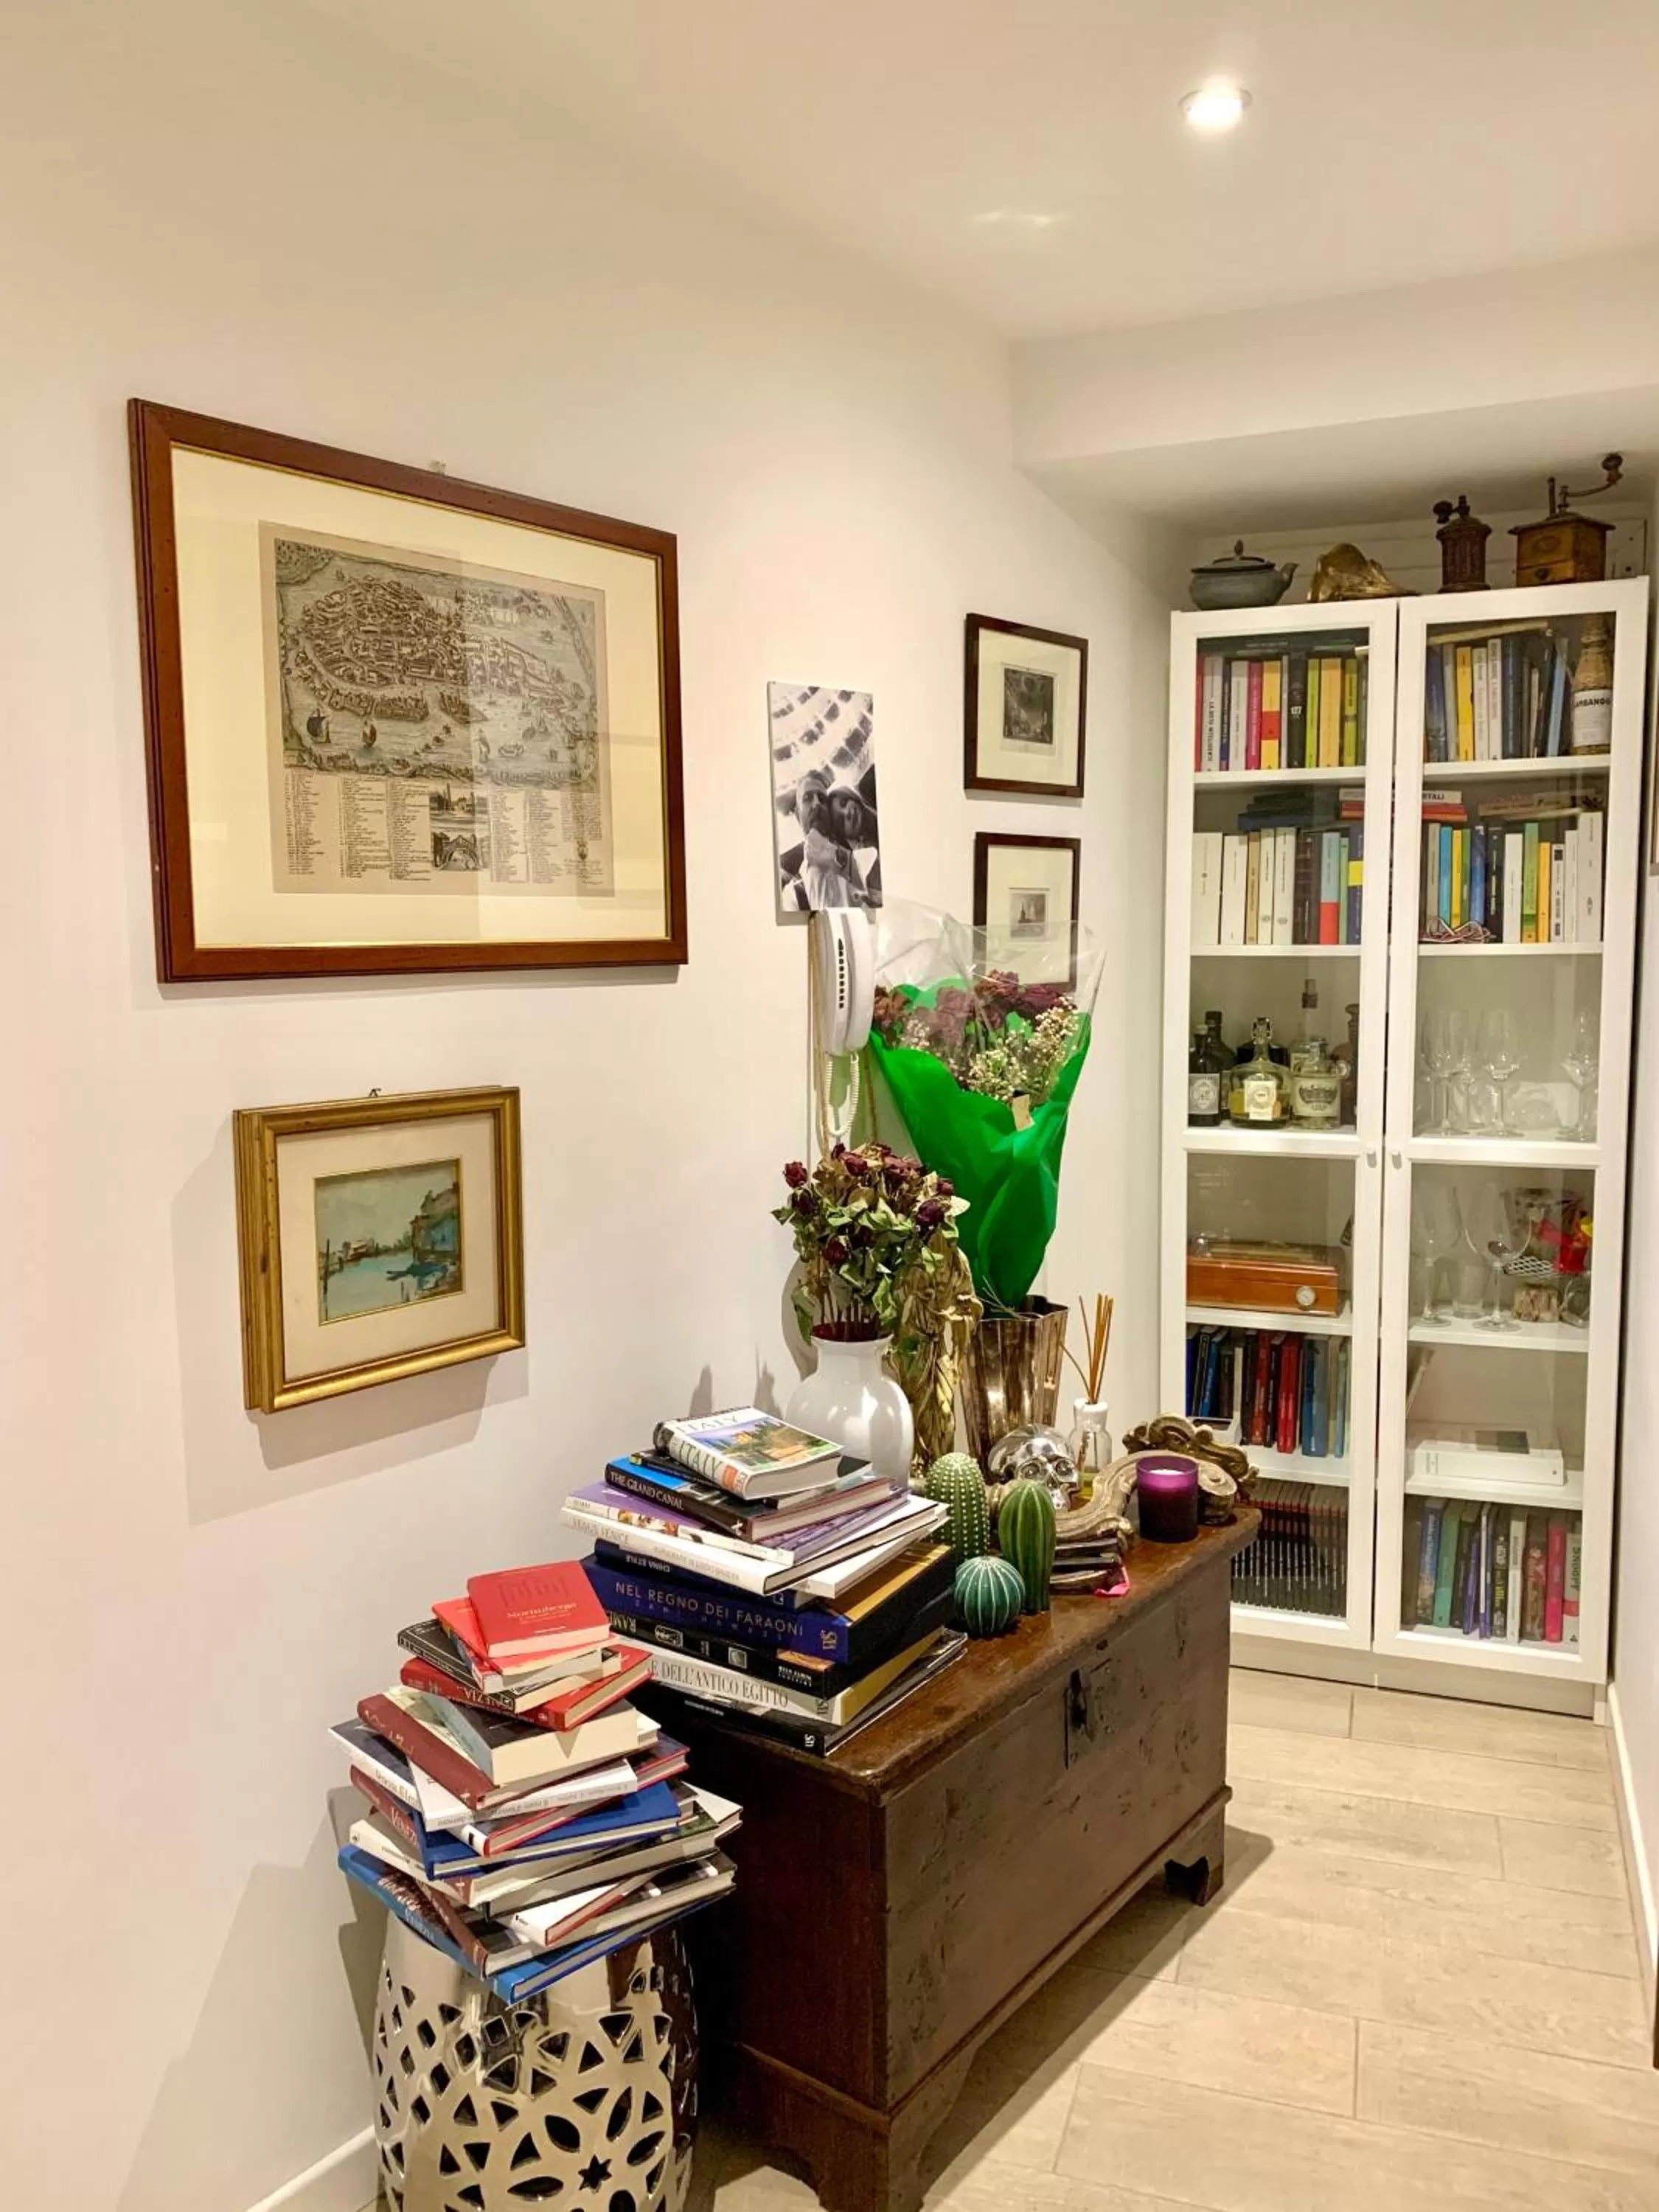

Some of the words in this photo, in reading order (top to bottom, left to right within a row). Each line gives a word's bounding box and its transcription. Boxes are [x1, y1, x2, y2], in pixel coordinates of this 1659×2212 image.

[679, 1439, 723, 1484] ITALY
[610, 1470, 627, 1487] THE
[627, 1478, 655, 1499] GRAND
[655, 1489, 685, 1511] CANAL
[615, 1581, 641, 1599] NEL
[647, 1588, 699, 1612] REGNO
[704, 1602, 729, 1618] DEI
[736, 1610, 804, 1636] FARAONI
[661, 1660, 739, 1694] DELL'ANTICO
[742, 1680, 790, 1708] EGITTO
